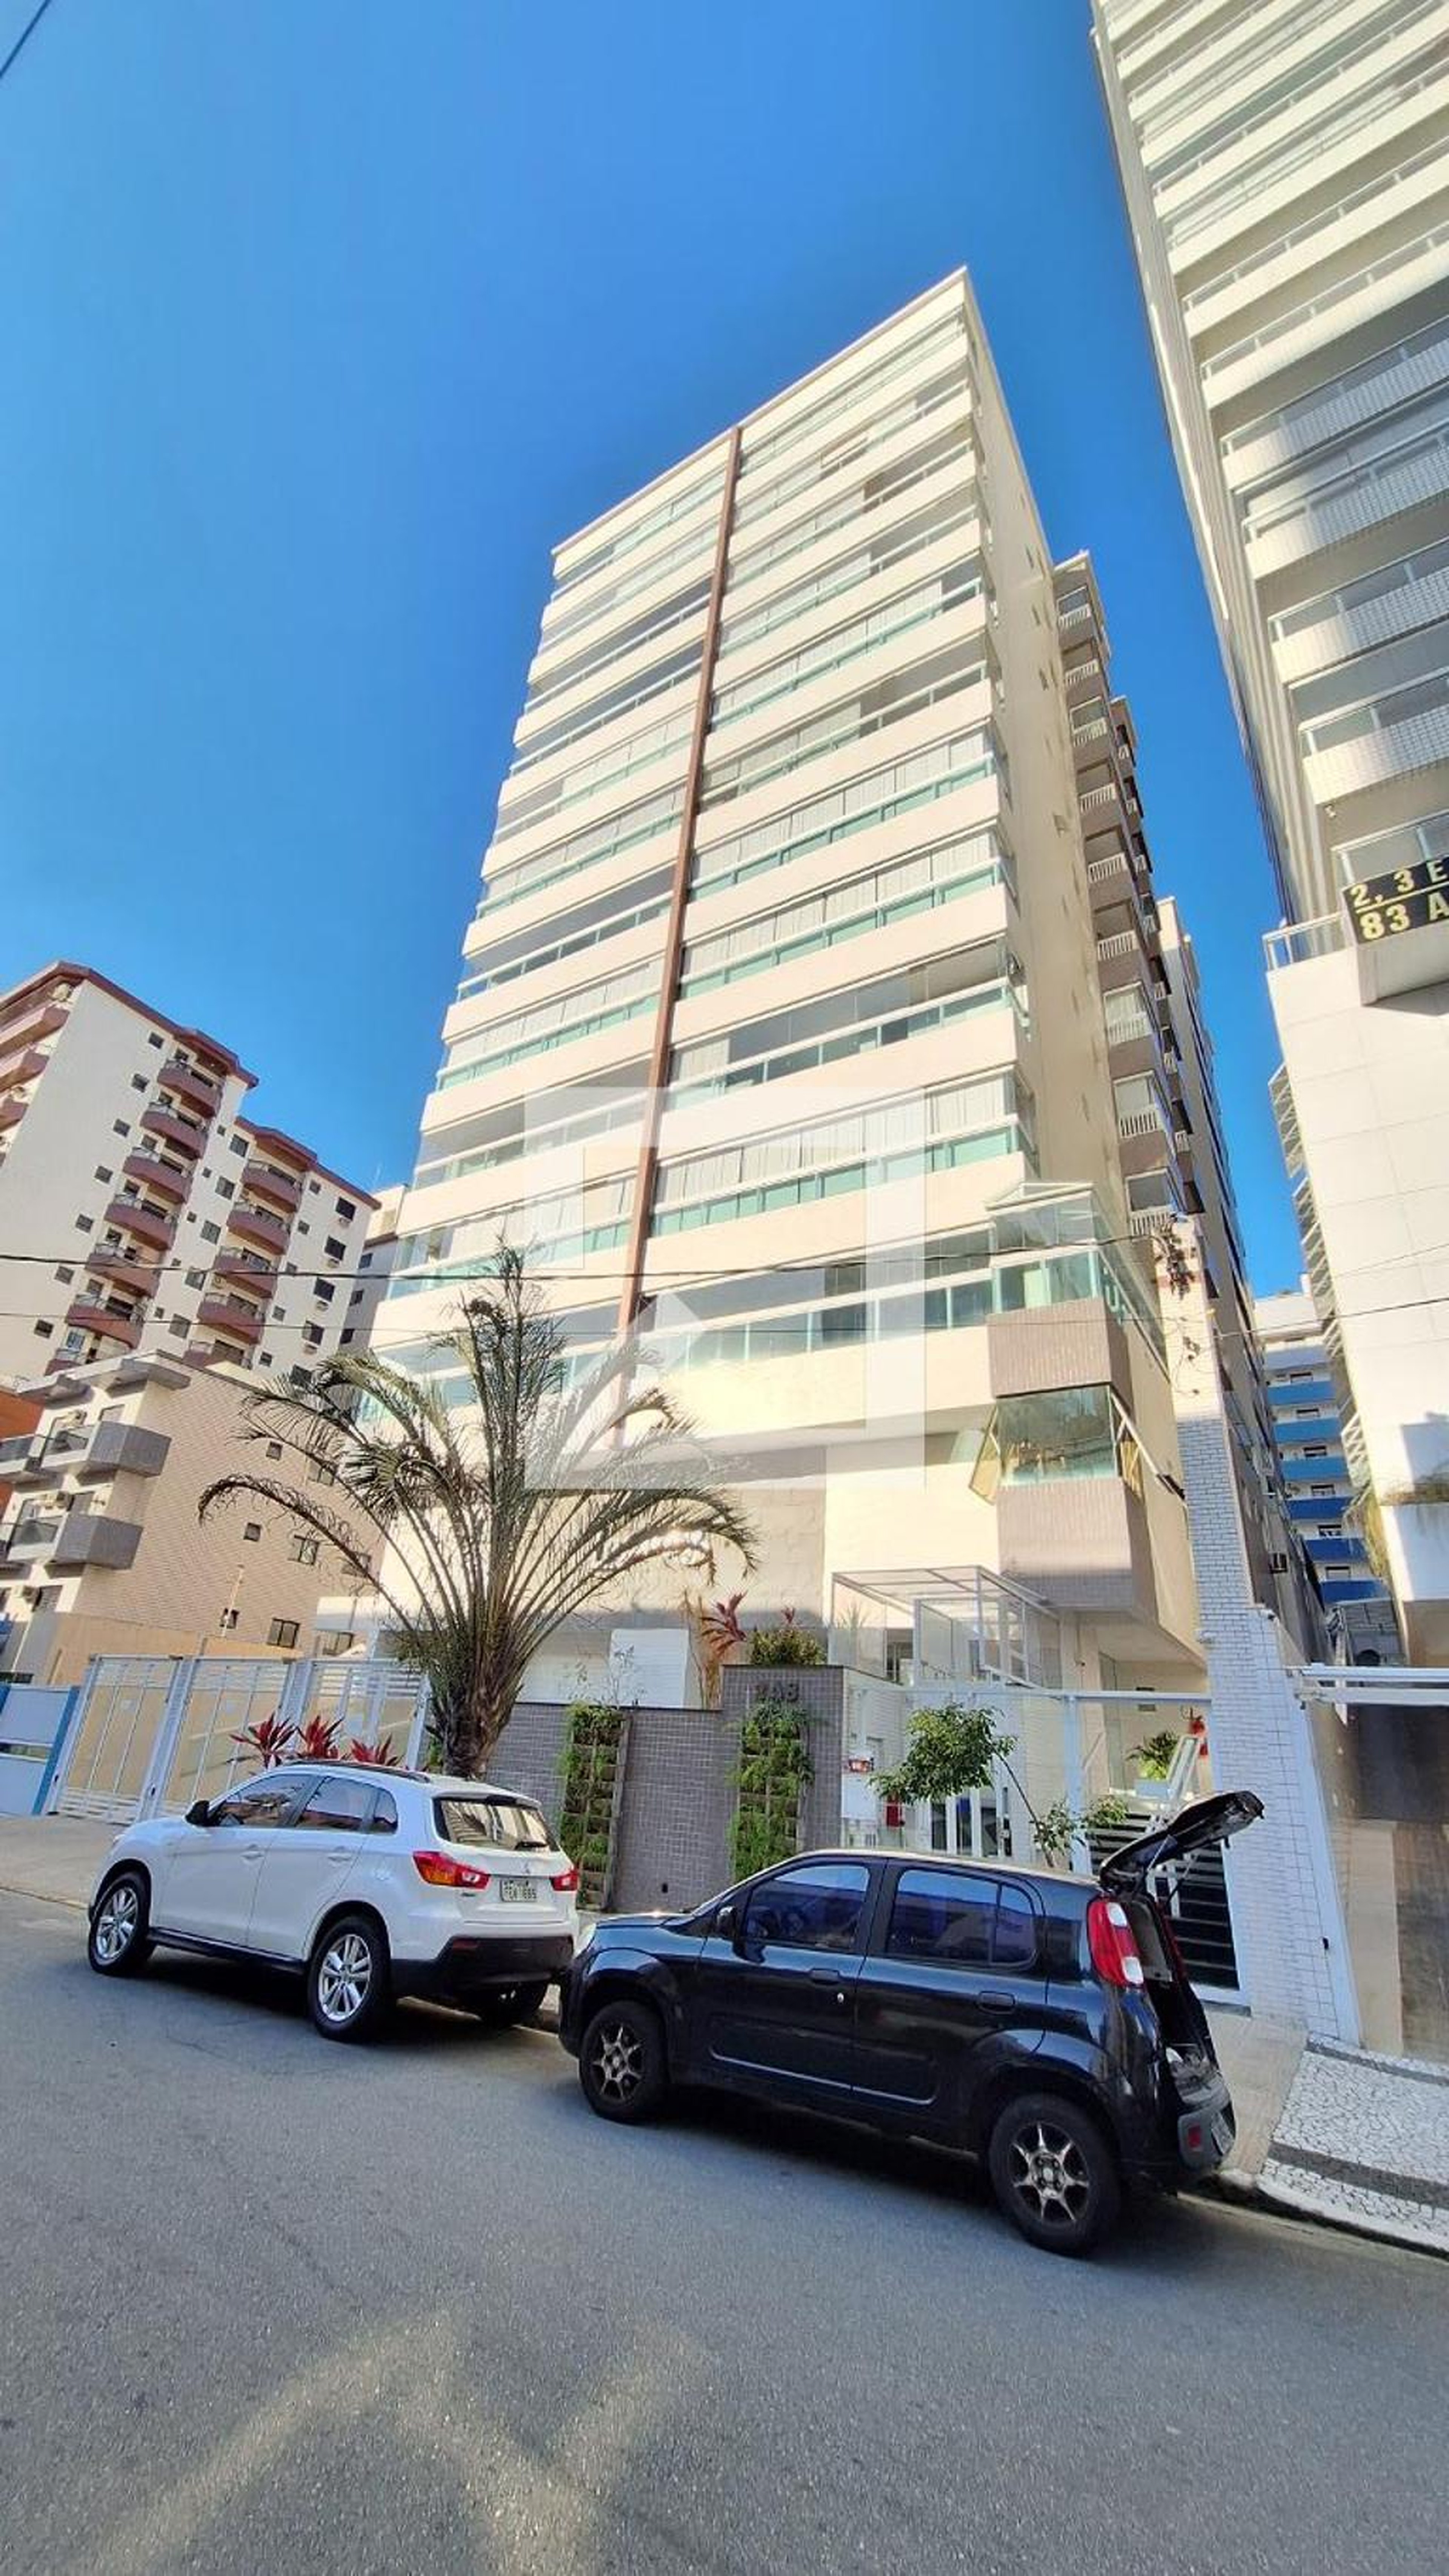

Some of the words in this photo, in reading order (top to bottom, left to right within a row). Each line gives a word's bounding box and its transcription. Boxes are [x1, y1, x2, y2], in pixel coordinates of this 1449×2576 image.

[1350, 884, 1383, 907] 2,
[1394, 869, 1414, 892] 3
[1426, 859, 1447, 883] E
[1360, 904, 1410, 939] 83
[1428, 892, 1449, 921] A
